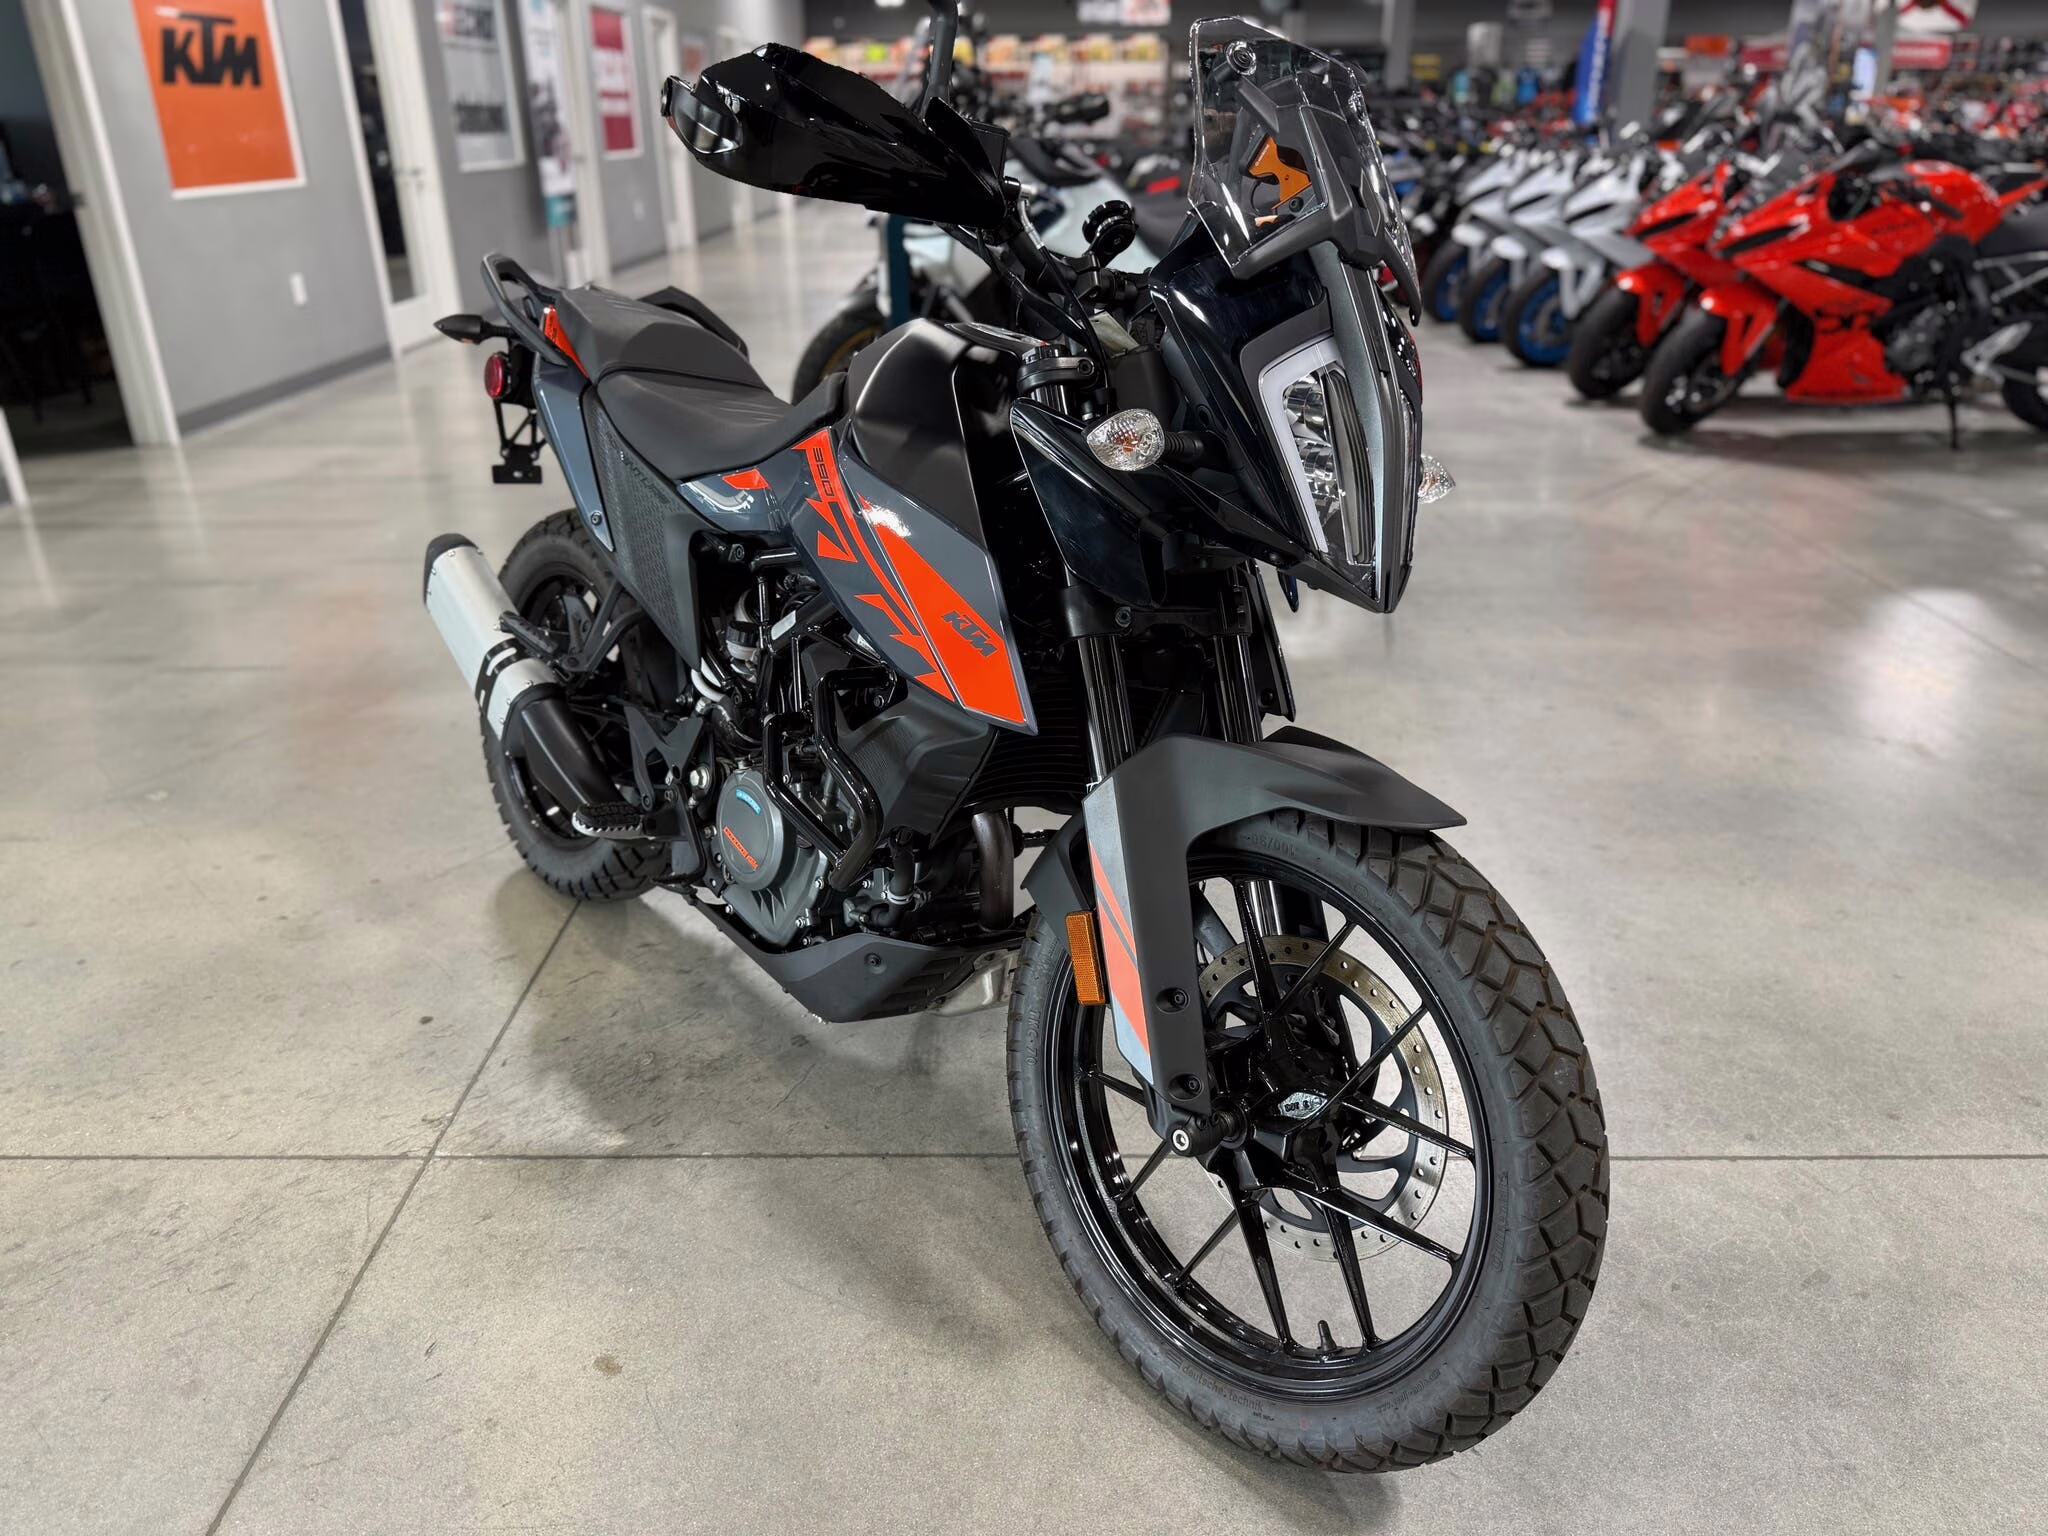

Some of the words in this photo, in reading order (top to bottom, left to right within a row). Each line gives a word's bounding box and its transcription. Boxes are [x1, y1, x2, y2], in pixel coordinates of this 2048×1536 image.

[161, 12, 262, 88] KTM
[812, 447, 835, 497] 390
[943, 611, 997, 656] KTM
